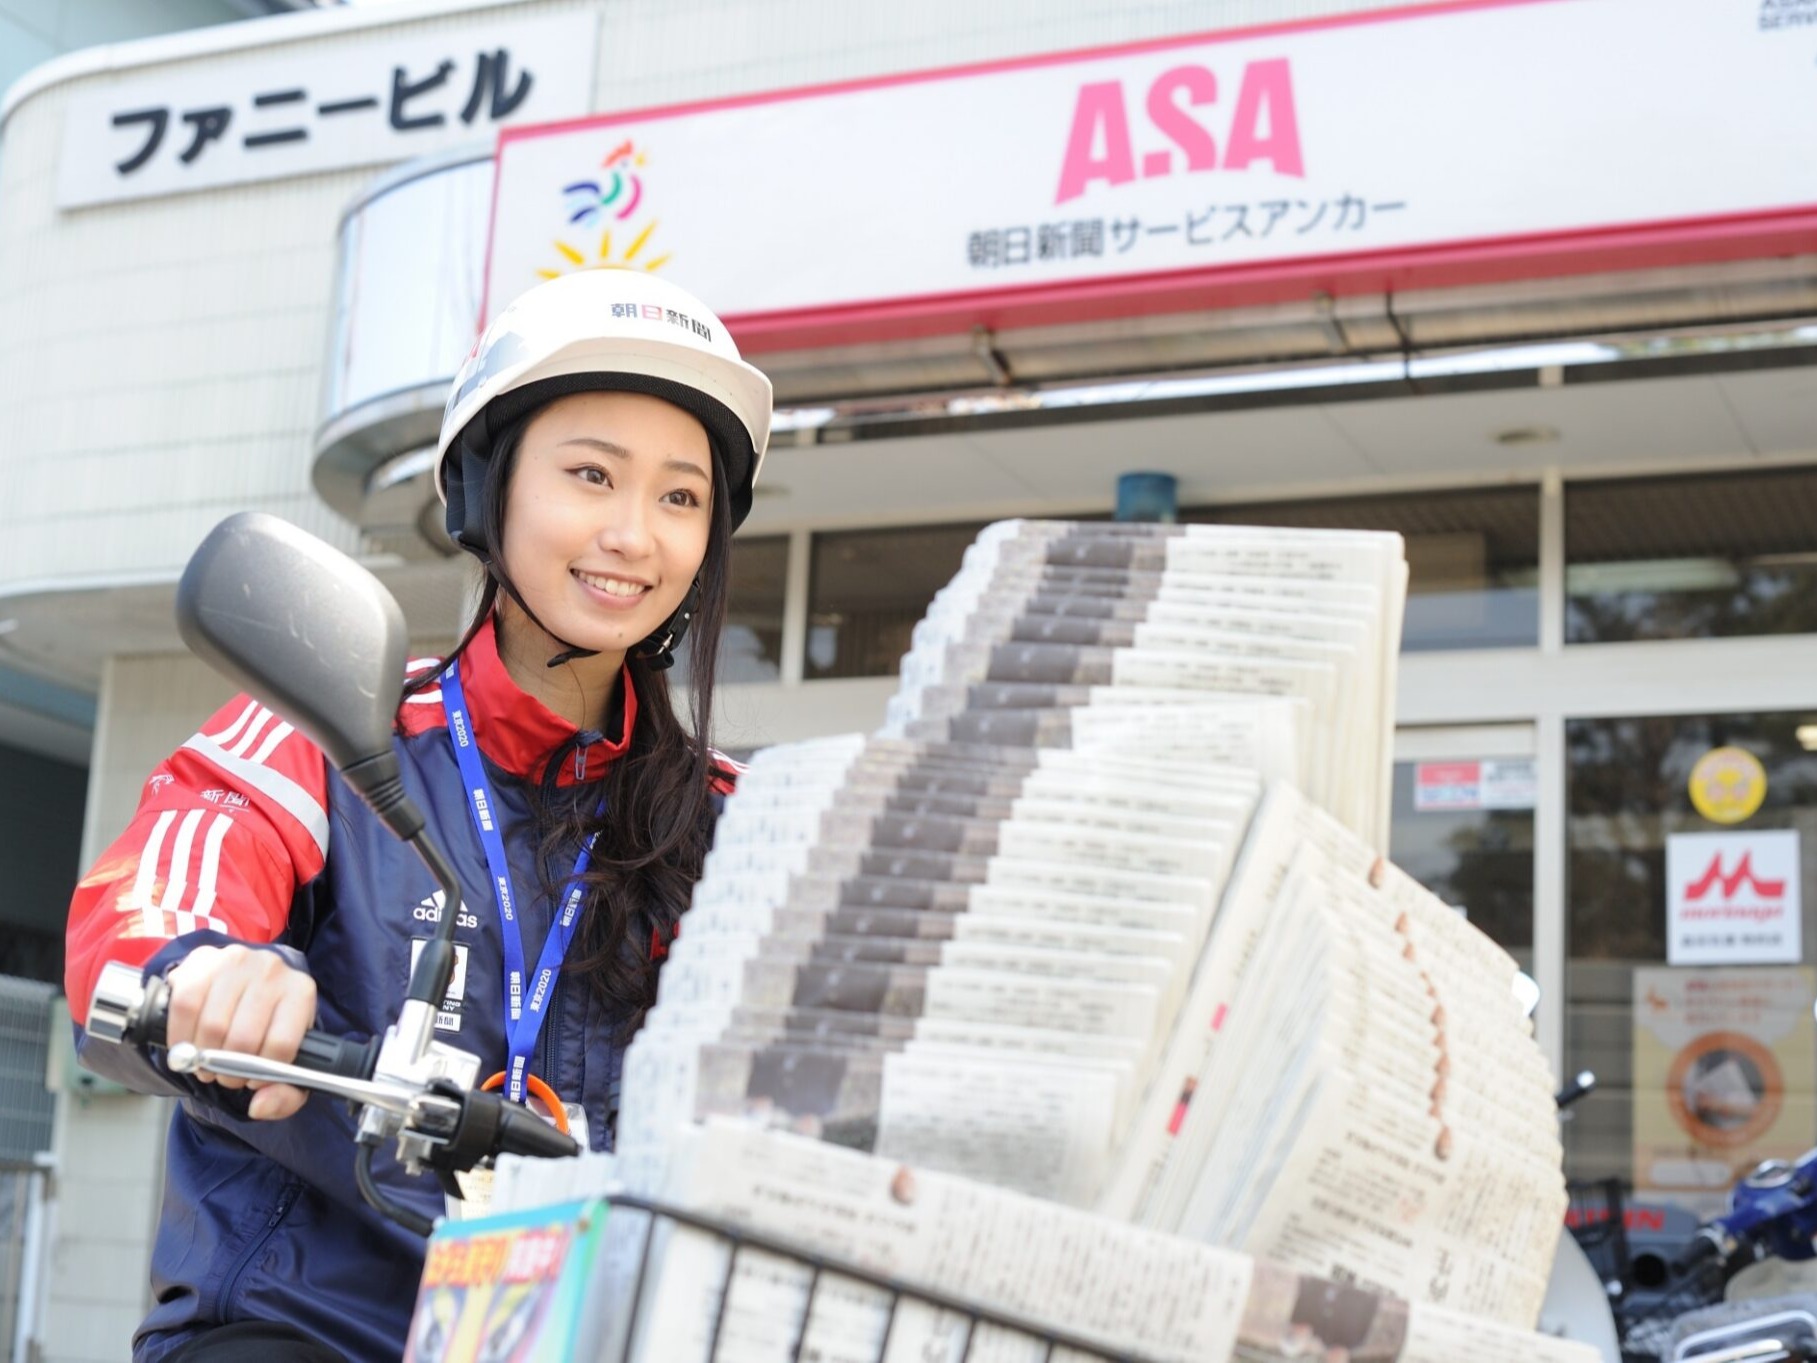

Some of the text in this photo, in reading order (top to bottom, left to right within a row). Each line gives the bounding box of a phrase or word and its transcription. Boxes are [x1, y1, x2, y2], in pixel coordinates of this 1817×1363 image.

[111, 48, 534, 175] ファニービル
[1054, 56, 1306, 207] ASA
[966, 193, 1407, 269] 朝日新聞サービスアンカー
[611, 302, 712, 342] 朝日新聞
[452, 710, 469, 748] 東京2020
[473, 788, 494, 831] 朝日新聞
[413, 906, 478, 929] adias
[498, 876, 514, 921] 東京2020
[510, 971, 522, 1020] 朝日新聞
[530, 969, 551, 1012] 東京2020
